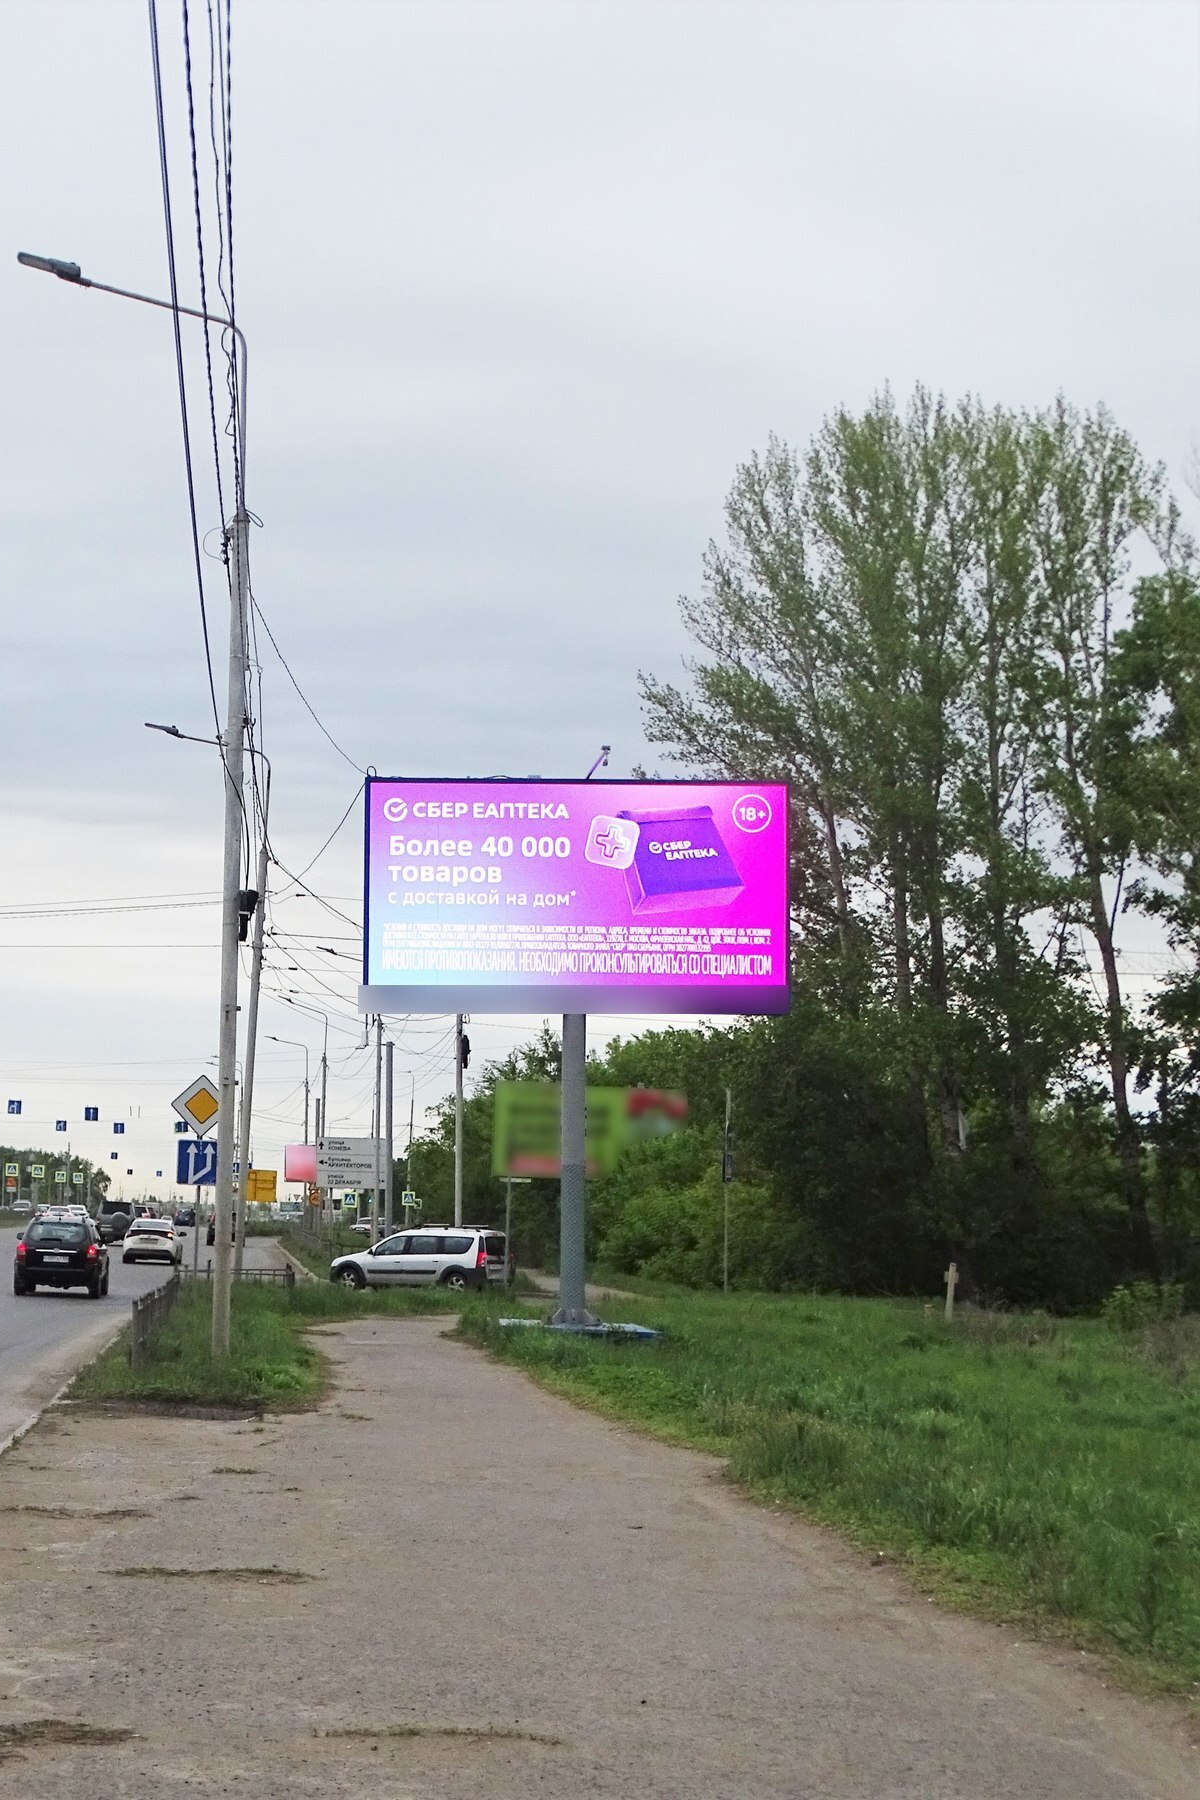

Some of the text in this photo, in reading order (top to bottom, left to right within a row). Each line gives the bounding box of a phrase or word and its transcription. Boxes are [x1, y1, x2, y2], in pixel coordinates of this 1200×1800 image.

[412, 802, 570, 819] СБЕР ЕАПТЕКА
[739, 807, 766, 821] 18+
[389, 835, 571, 858] Более 40 000
[662, 841, 692, 851] СБЕР
[665, 848, 718, 861] ЕАПТЕКА
[388, 865, 502, 887] товаров
[388, 892, 397, 904] с
[402, 889, 499, 906] доставкой
[506, 893, 527, 905] на
[382, 949, 772, 978] ИМЕЮТСЯ ПРОТИВОПОКАЗАНИЯ. НЕОБХОДИМО ПРОКОНСУЛЬТИРОВАТЬСЯ СО СПЕЦИАЛИСТОМ
